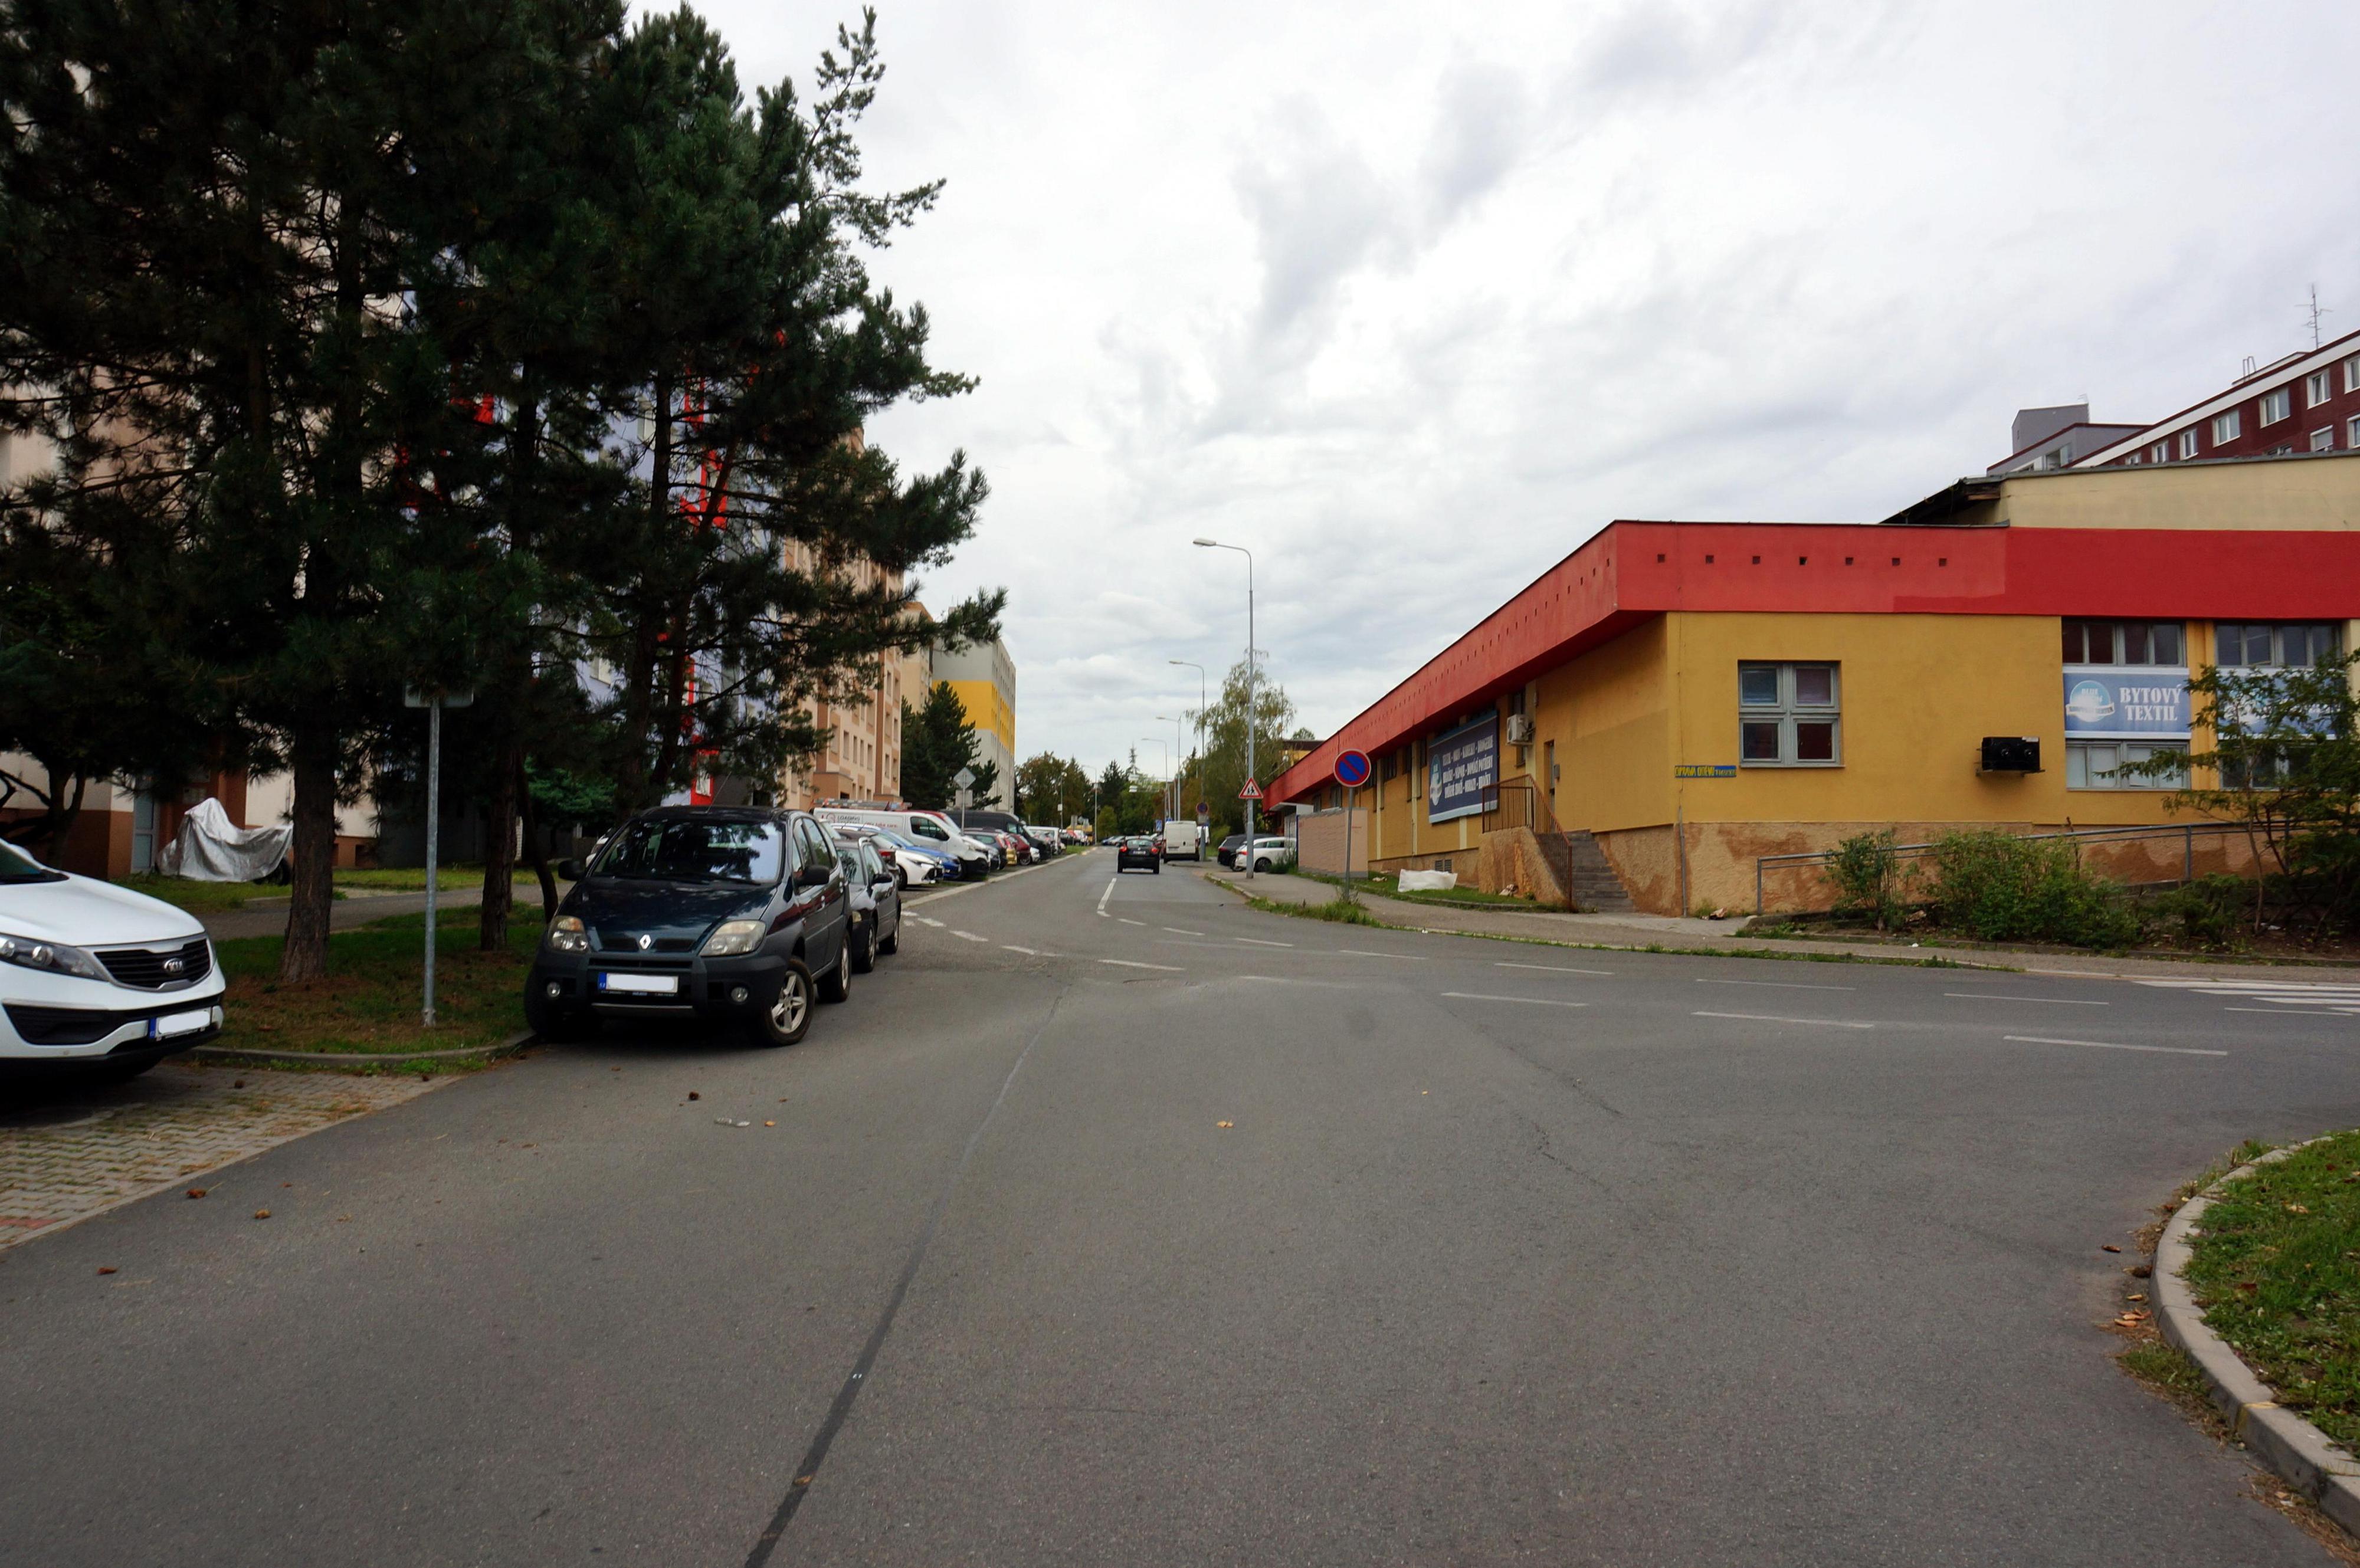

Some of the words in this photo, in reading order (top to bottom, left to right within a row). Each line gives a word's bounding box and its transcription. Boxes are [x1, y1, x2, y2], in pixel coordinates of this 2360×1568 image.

[2119, 684, 2182, 703] BYTOVÝ
[2124, 705, 2178, 721] TEXTIL
[168, 960, 184, 972] KIA
